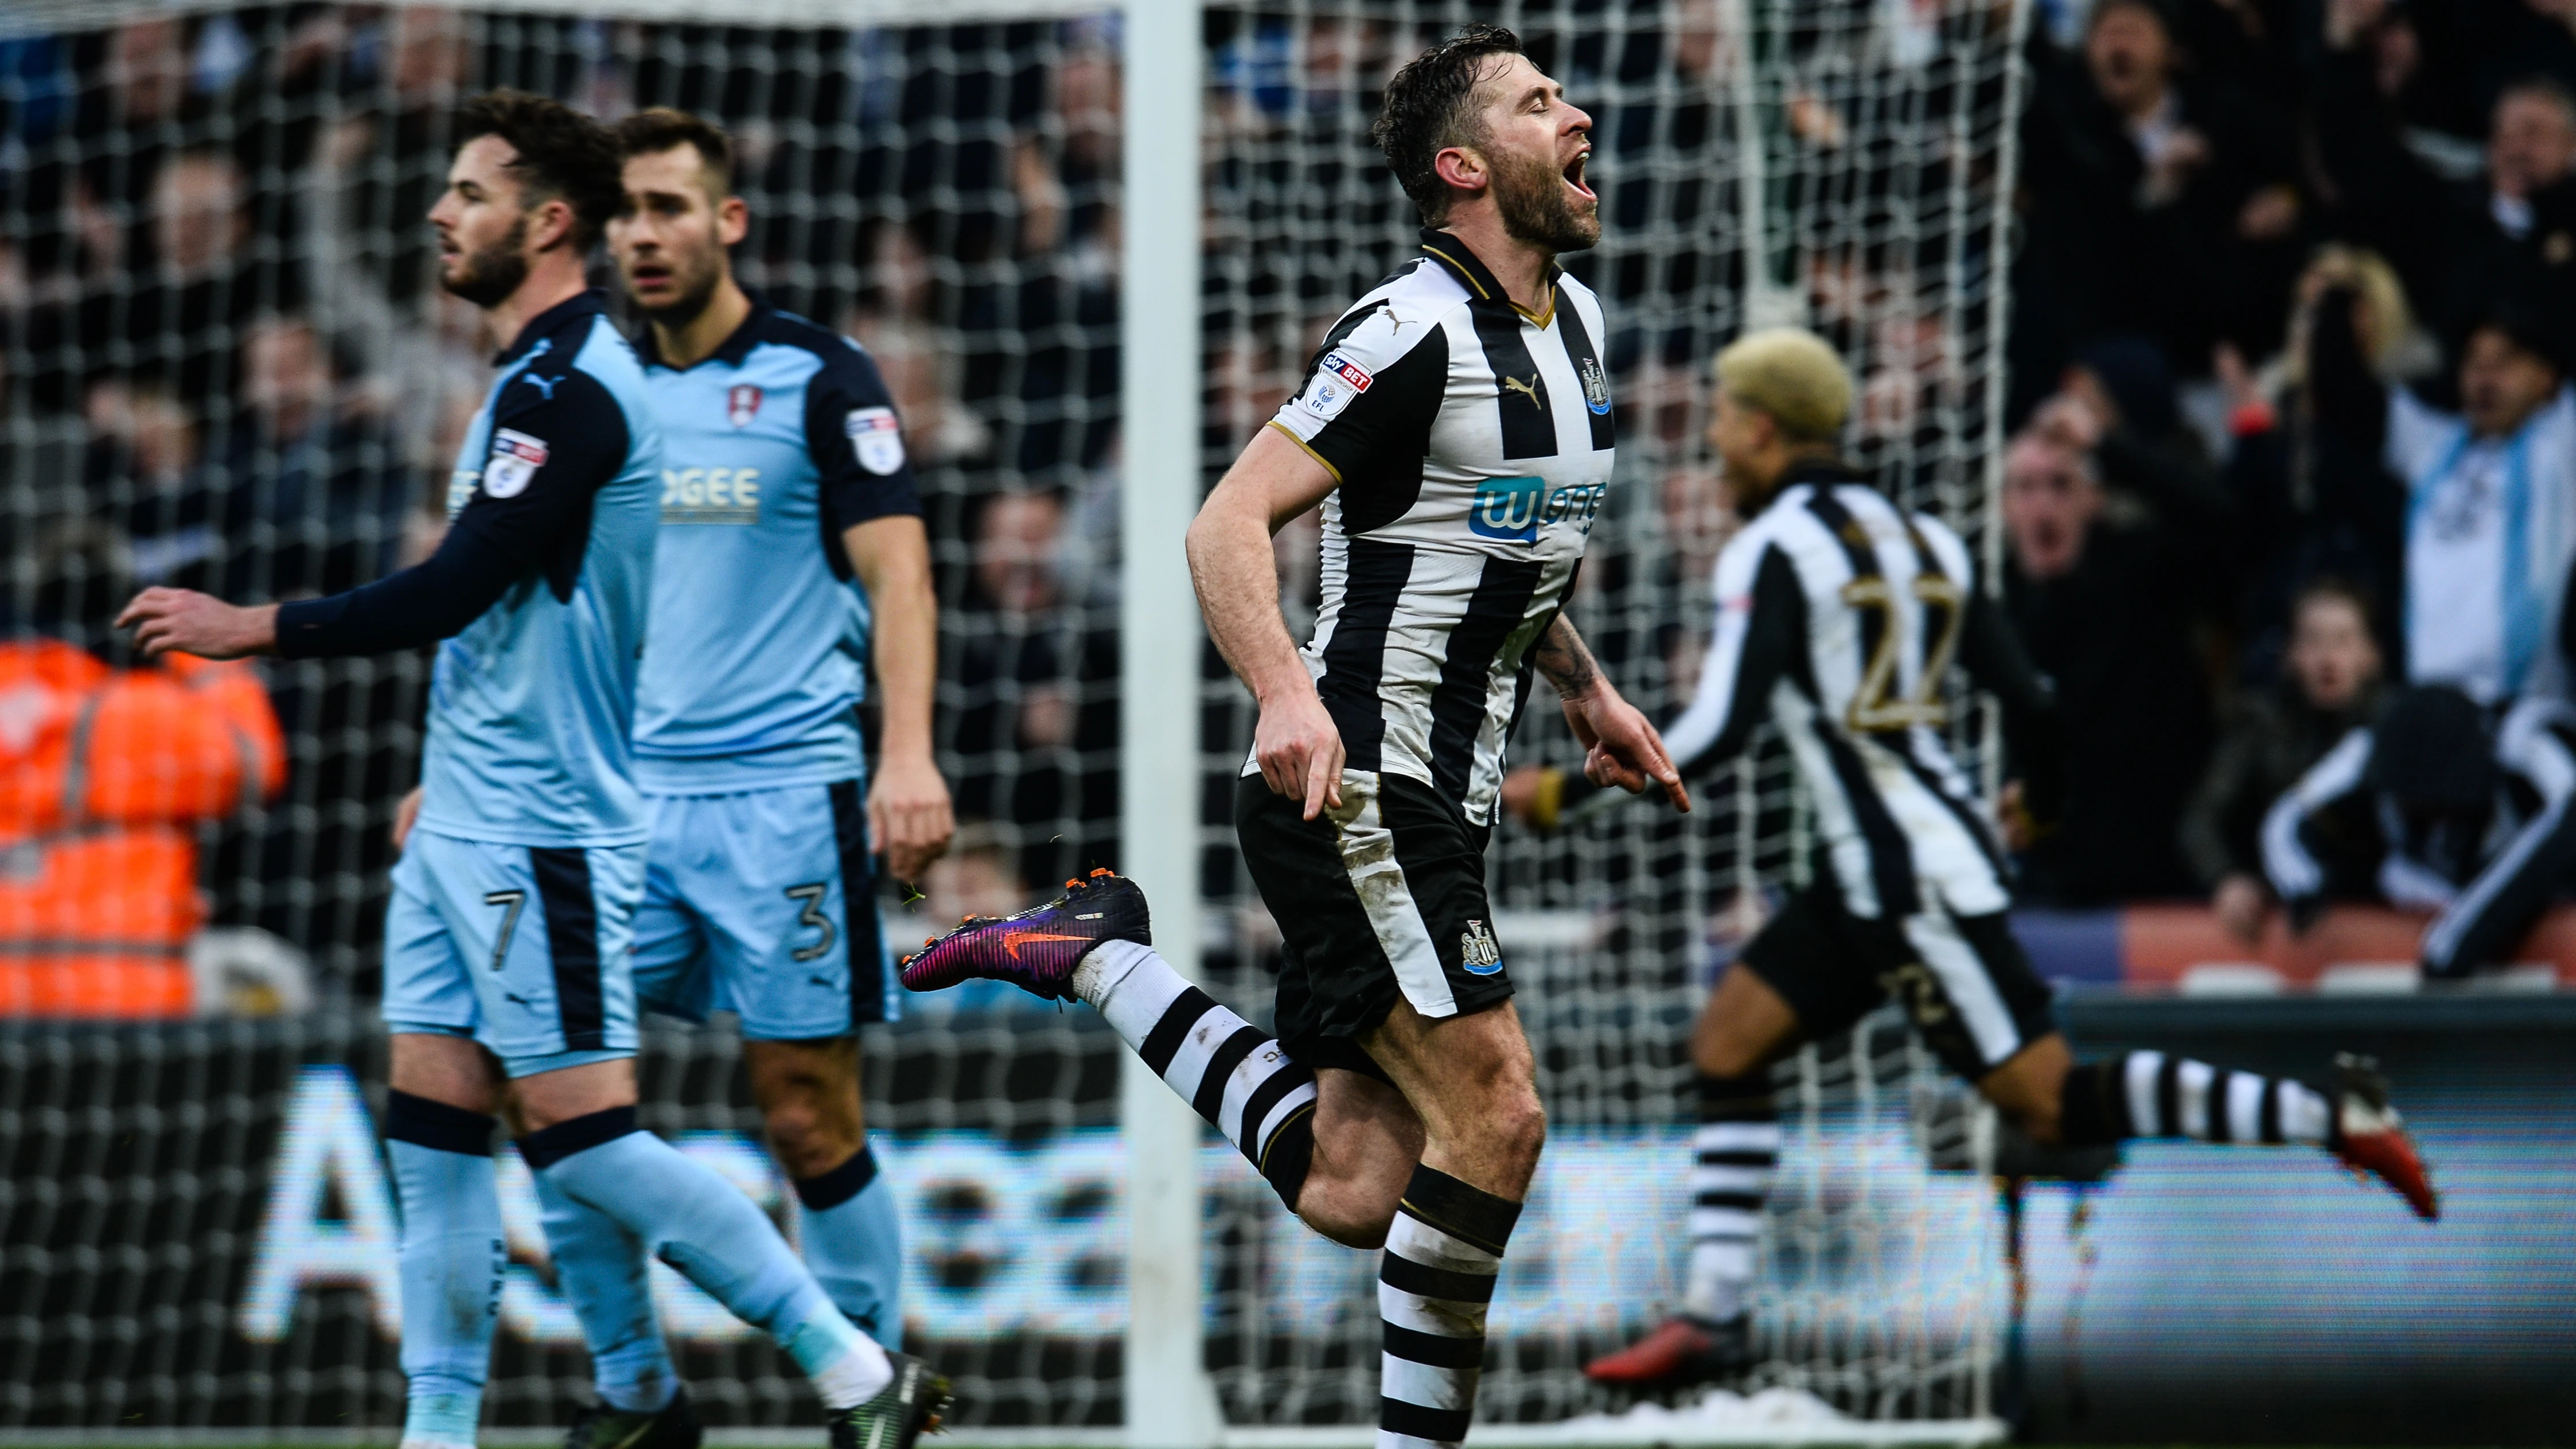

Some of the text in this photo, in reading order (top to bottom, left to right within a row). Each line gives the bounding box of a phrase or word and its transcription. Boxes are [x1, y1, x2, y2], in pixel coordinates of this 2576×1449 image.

[1311, 400, 1324, 412] EFL
[1343, 366, 1368, 387] BET
[1841, 574, 1963, 731] 22
[485, 889, 525, 972] 7
[785, 882, 836, 963] 3
